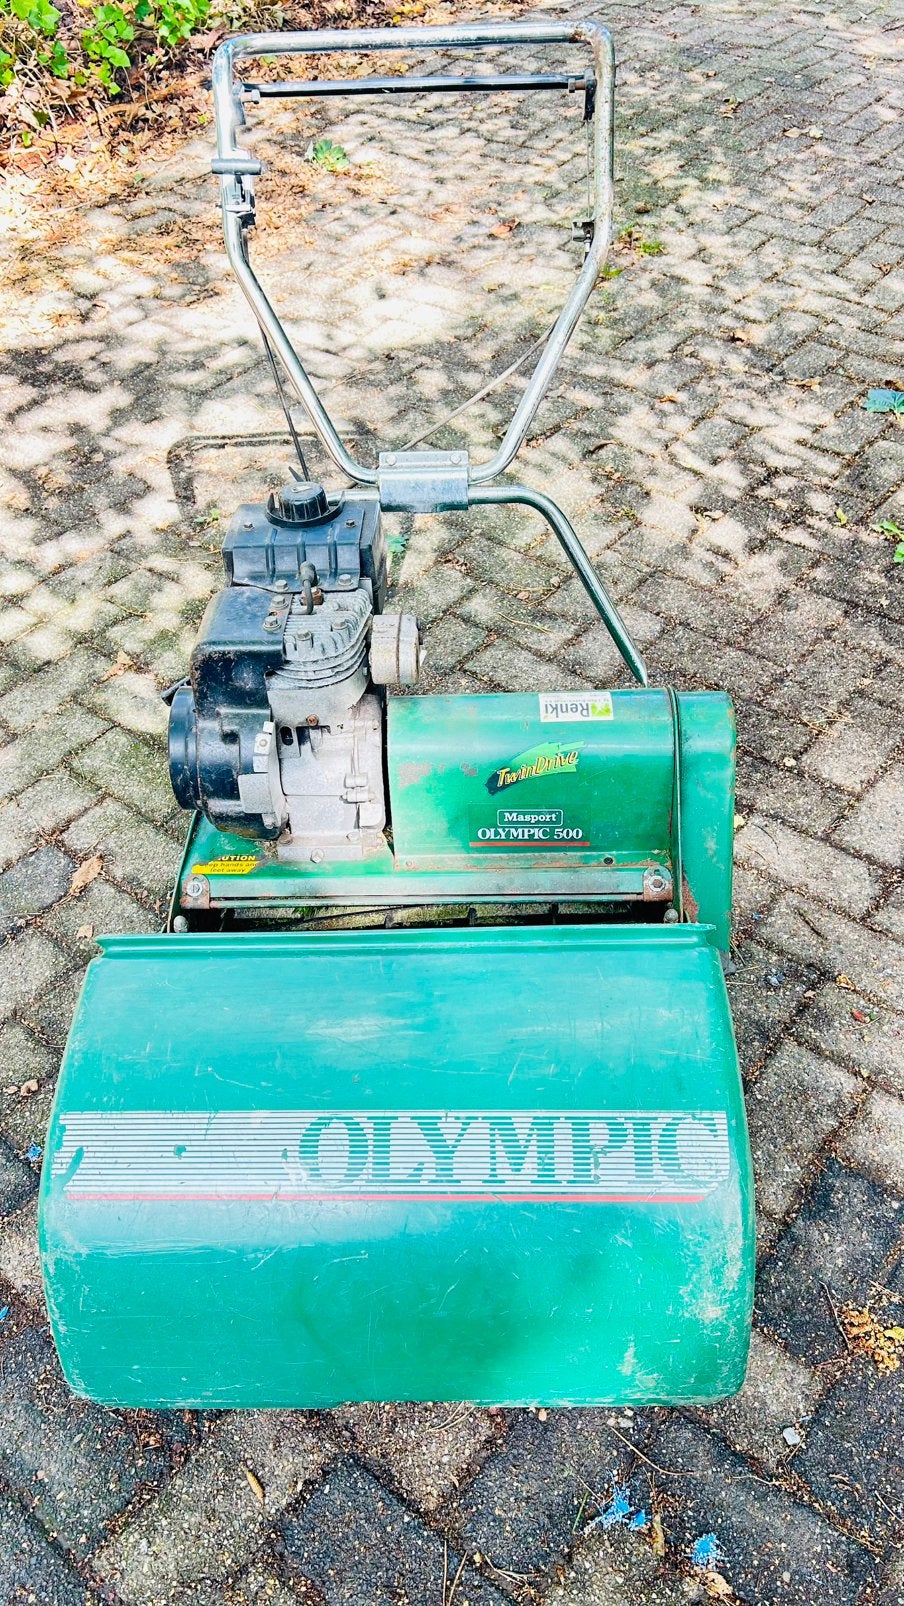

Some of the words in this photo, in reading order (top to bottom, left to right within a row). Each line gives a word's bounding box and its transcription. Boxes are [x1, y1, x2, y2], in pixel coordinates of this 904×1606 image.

[545, 702, 590, 719] Renki
[496, 750, 579, 787] TwinDrive
[503, 811, 557, 824] Masport
[477, 827, 550, 840] OLYMPIC
[553, 828, 583, 840] 500
[299, 1115, 717, 1185] OLYMPIC
